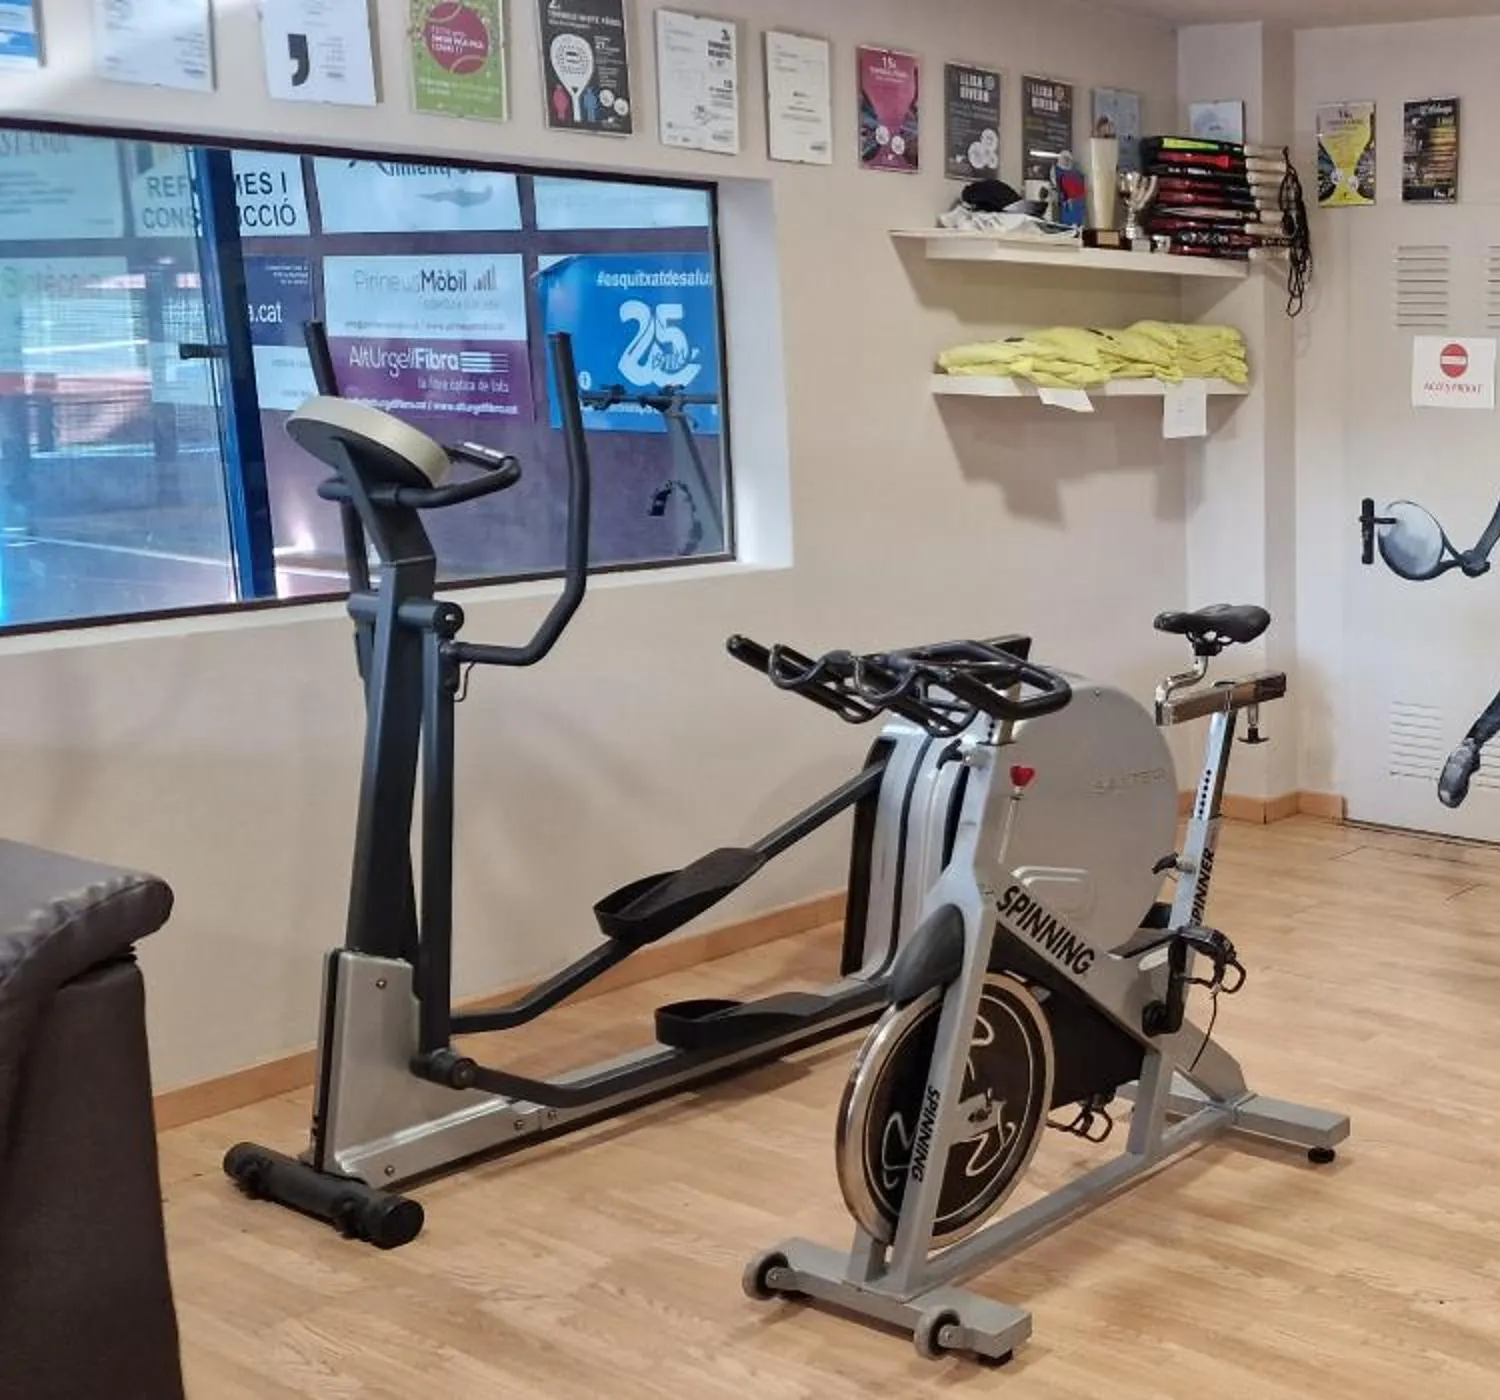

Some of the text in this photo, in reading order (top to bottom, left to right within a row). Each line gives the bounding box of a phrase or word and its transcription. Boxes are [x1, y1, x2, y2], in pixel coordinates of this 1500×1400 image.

[142, 196, 297, 230] CONSCCIÓ
[148, 173, 273, 198] REFES
[618, 300, 702, 387] 25
[996, 885, 1095, 975] SPINNING
[911, 1085, 941, 1183] SPINNING
